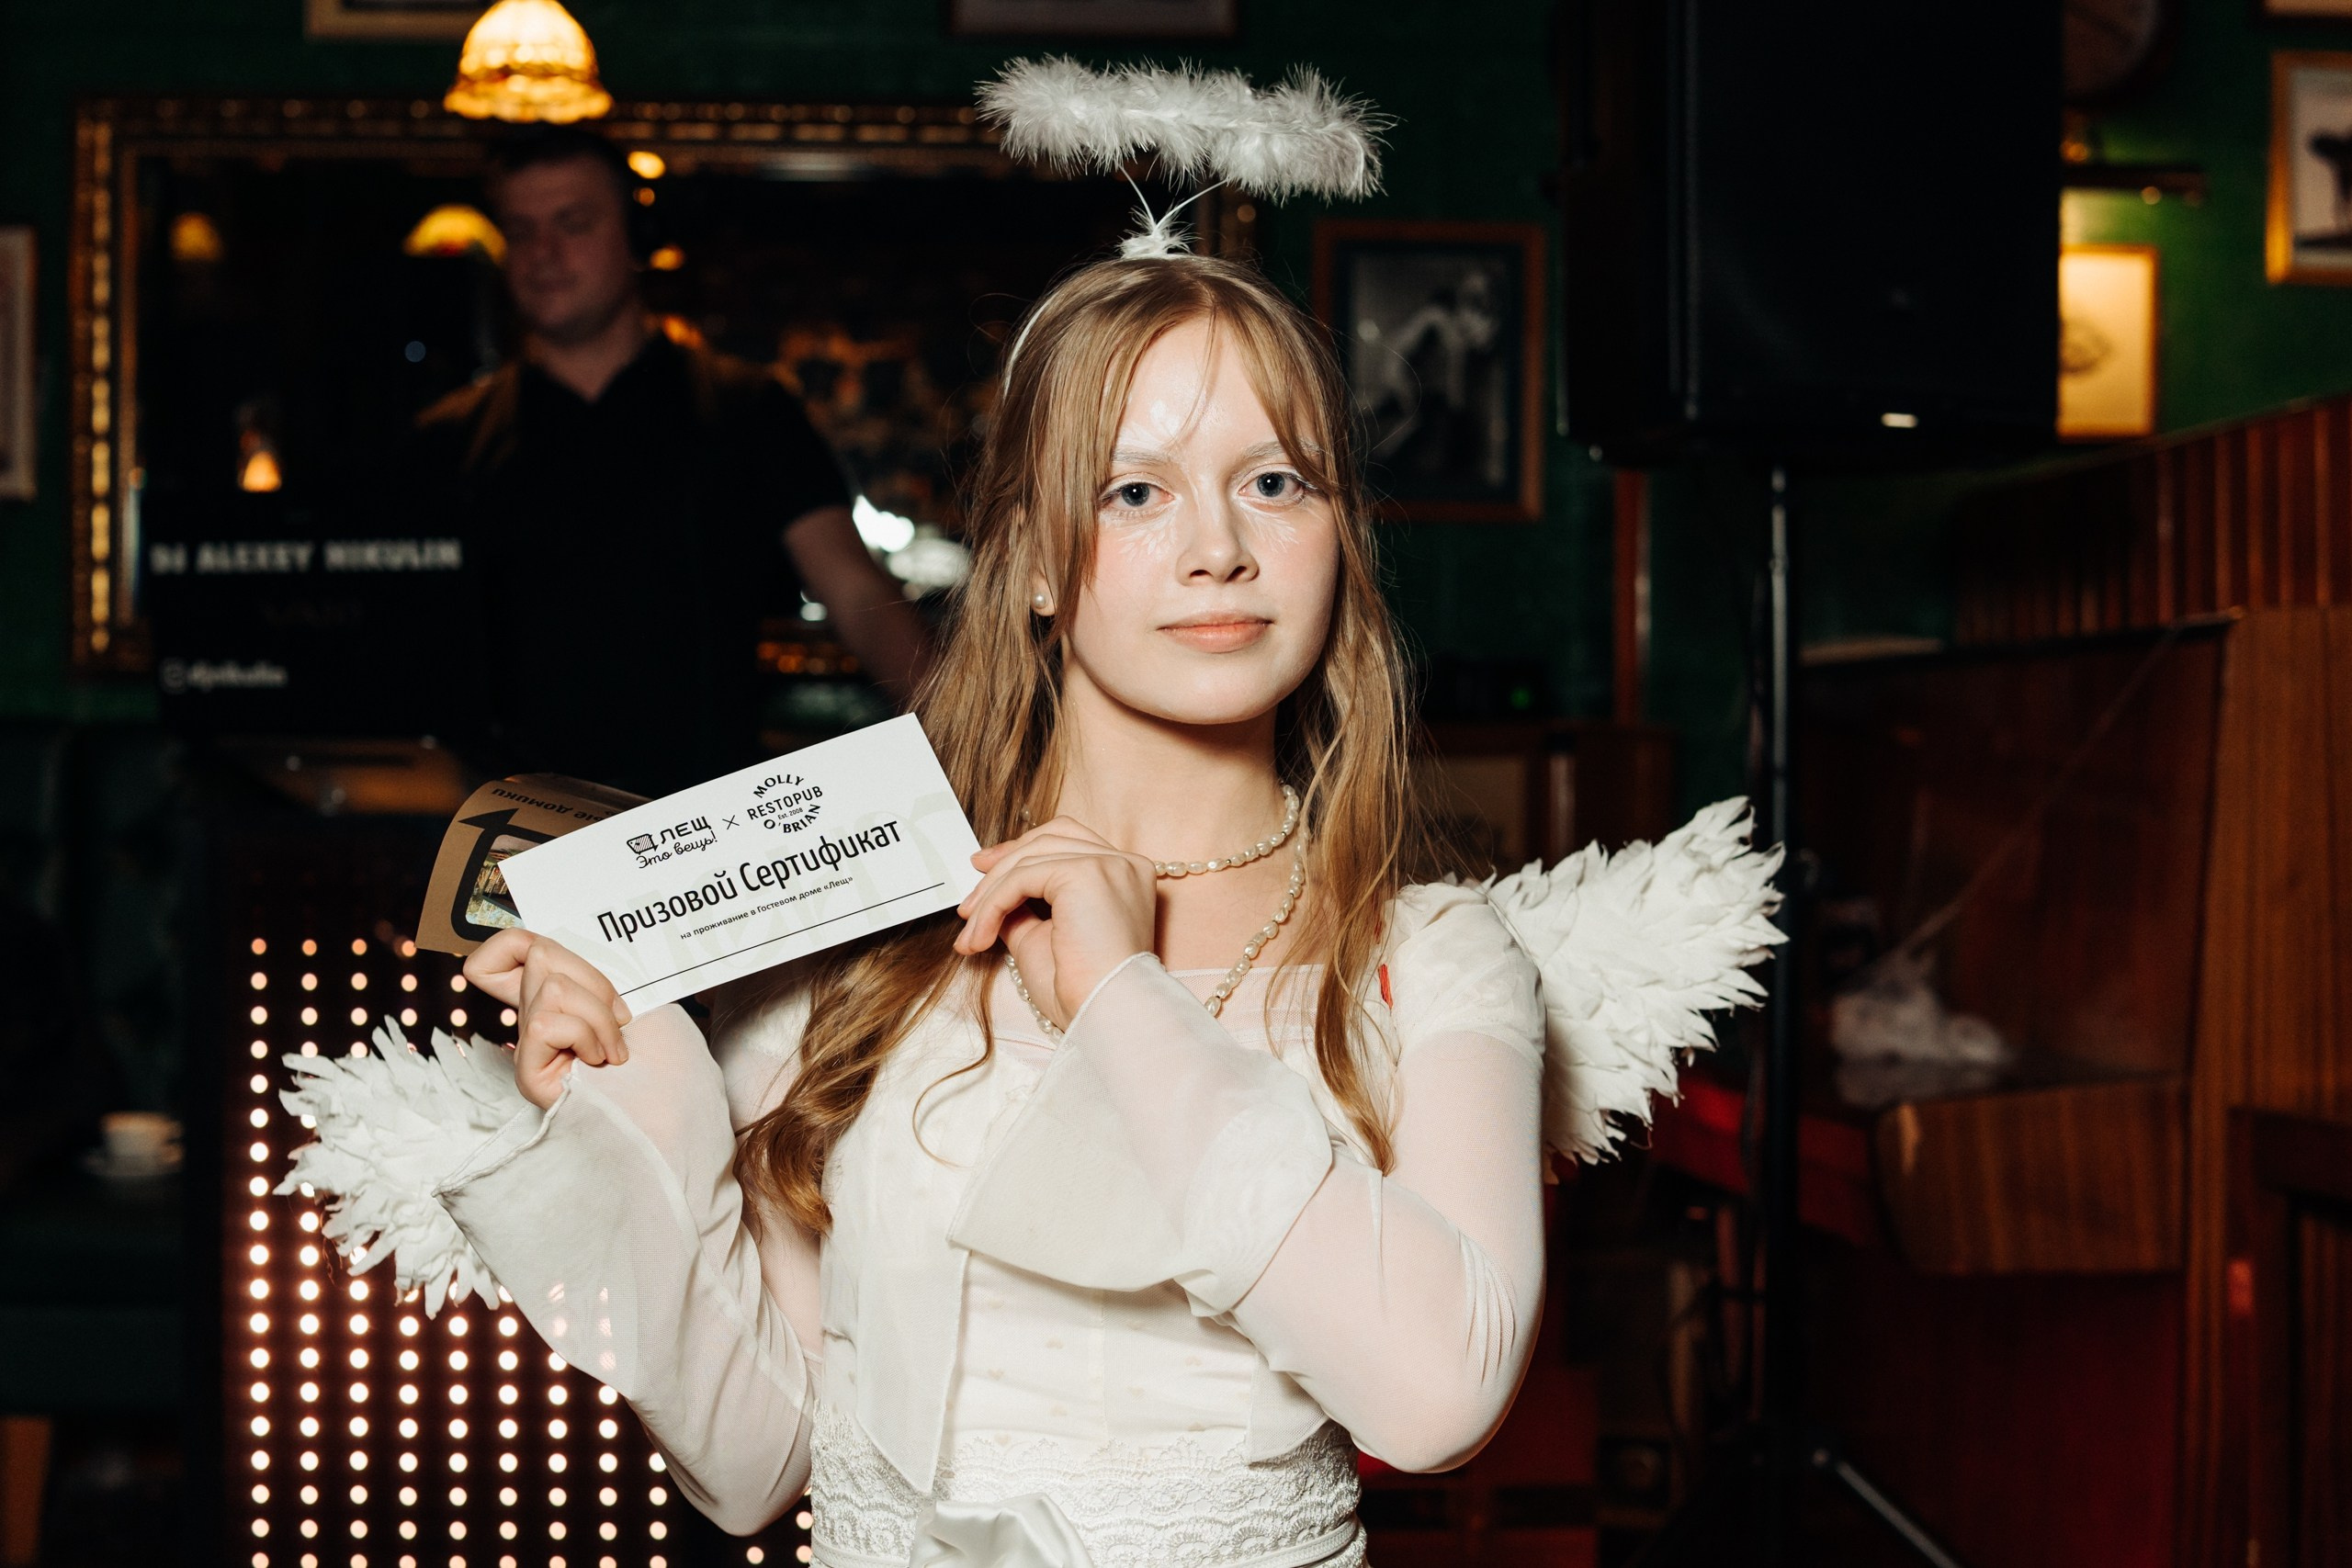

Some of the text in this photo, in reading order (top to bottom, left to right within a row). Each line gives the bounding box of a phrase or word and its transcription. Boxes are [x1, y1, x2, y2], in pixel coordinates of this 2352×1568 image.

[492, 788, 573, 814] домики
[746, 785, 823, 820] RESTOPUB
[753, 773, 804, 798] MOLLY
[777, 807, 804, 820] Est. 2008
[636, 829, 718, 869] Это вещь!
[597, 820, 901, 942] Призовой Сертификат
[680, 930, 692, 940] на
[694, 912, 750, 935] проживание
[758, 896, 798, 915] Гостевом
[798, 883, 822, 900] доме
[823, 876, 854, 891] «Лещ»
